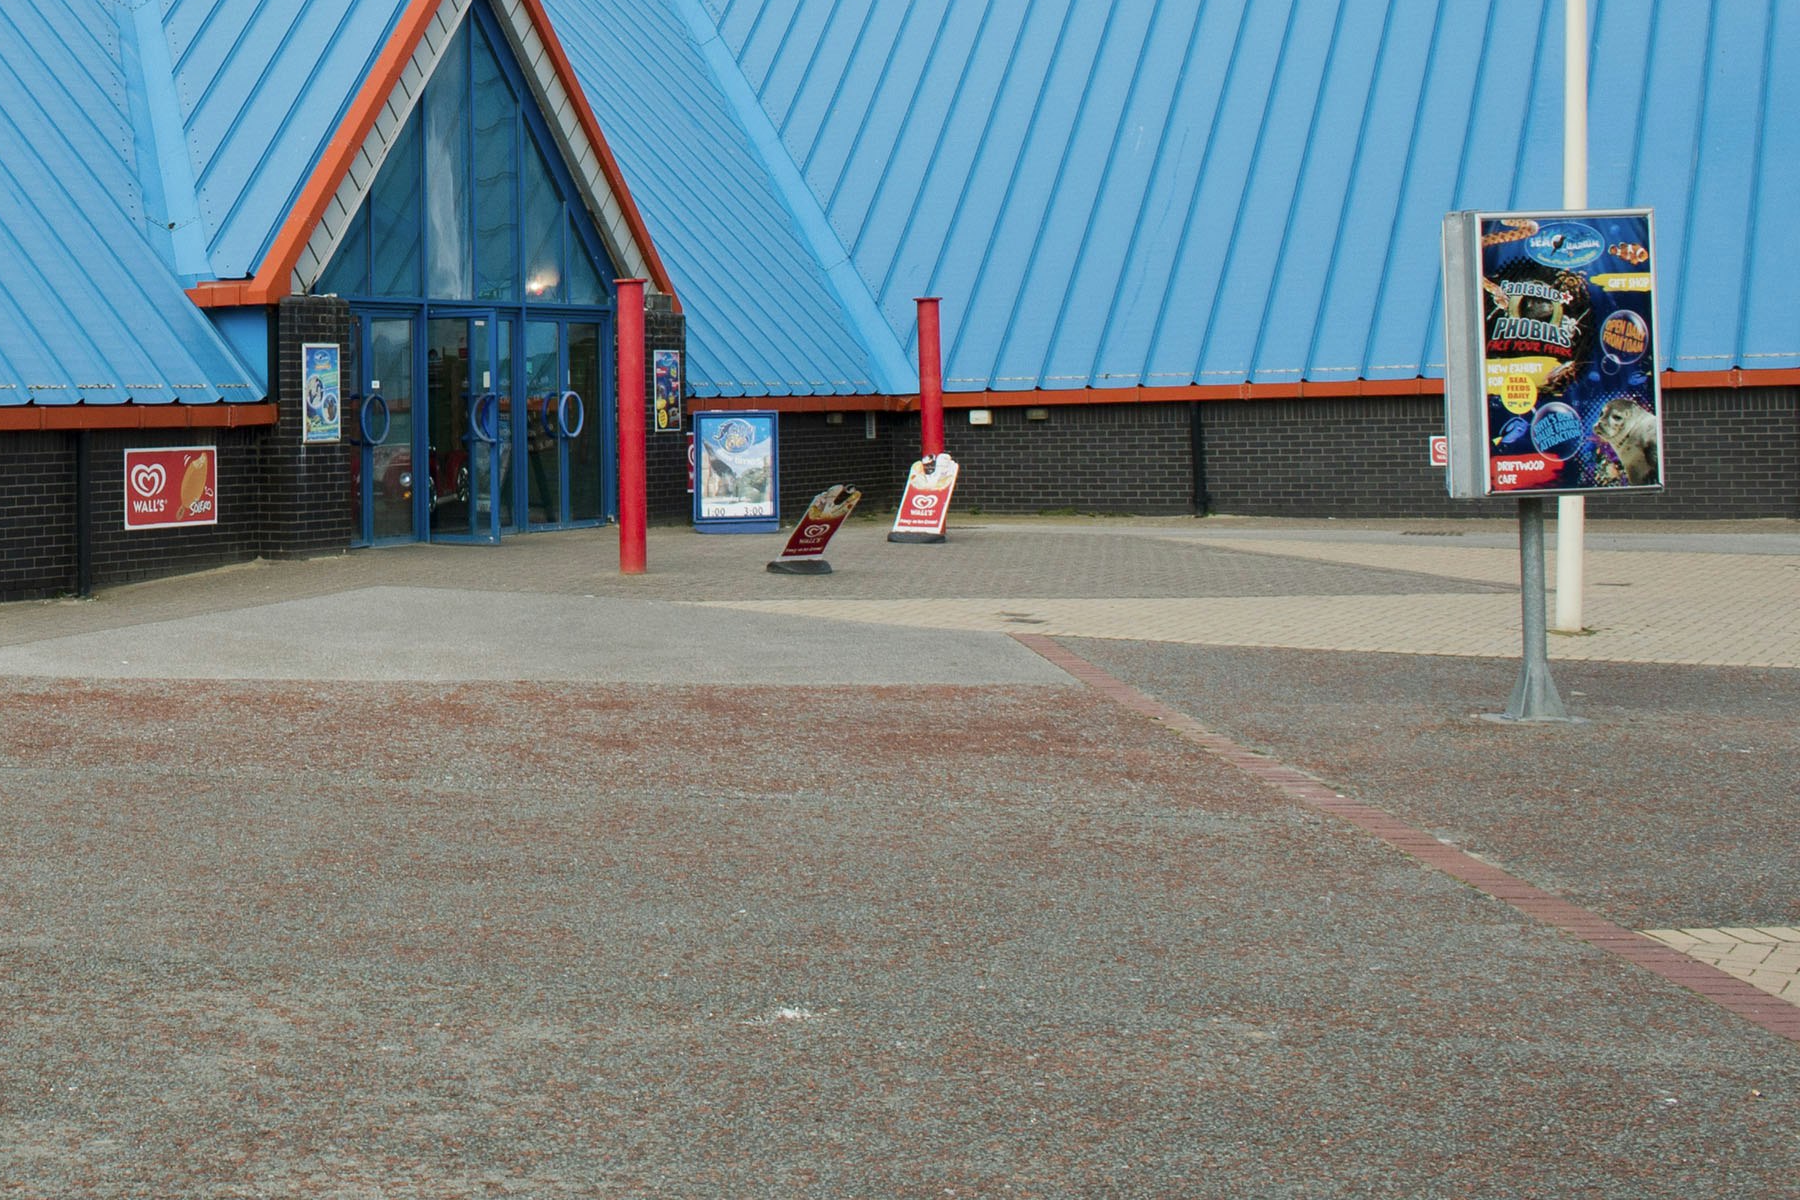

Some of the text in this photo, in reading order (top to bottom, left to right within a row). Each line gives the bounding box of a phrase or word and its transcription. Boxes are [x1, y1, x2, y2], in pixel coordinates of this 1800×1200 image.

[1608, 277, 1650, 289] GIFT SHOP
[1501, 279, 1561, 302] Fantastic
[1492, 317, 1571, 348] PHOBIAS
[1606, 319, 1627, 336] OPEN
[1487, 340, 1511, 352] FACE
[1513, 340, 1542, 352] YOUR
[1603, 330, 1624, 350] FROM
[1488, 363, 1543, 374] NEW EXHIBIT
[1488, 377, 1504, 386] FOR
[1497, 460, 1545, 471] DRIFTWOOD
[1498, 474, 1517, 484] CAFE
